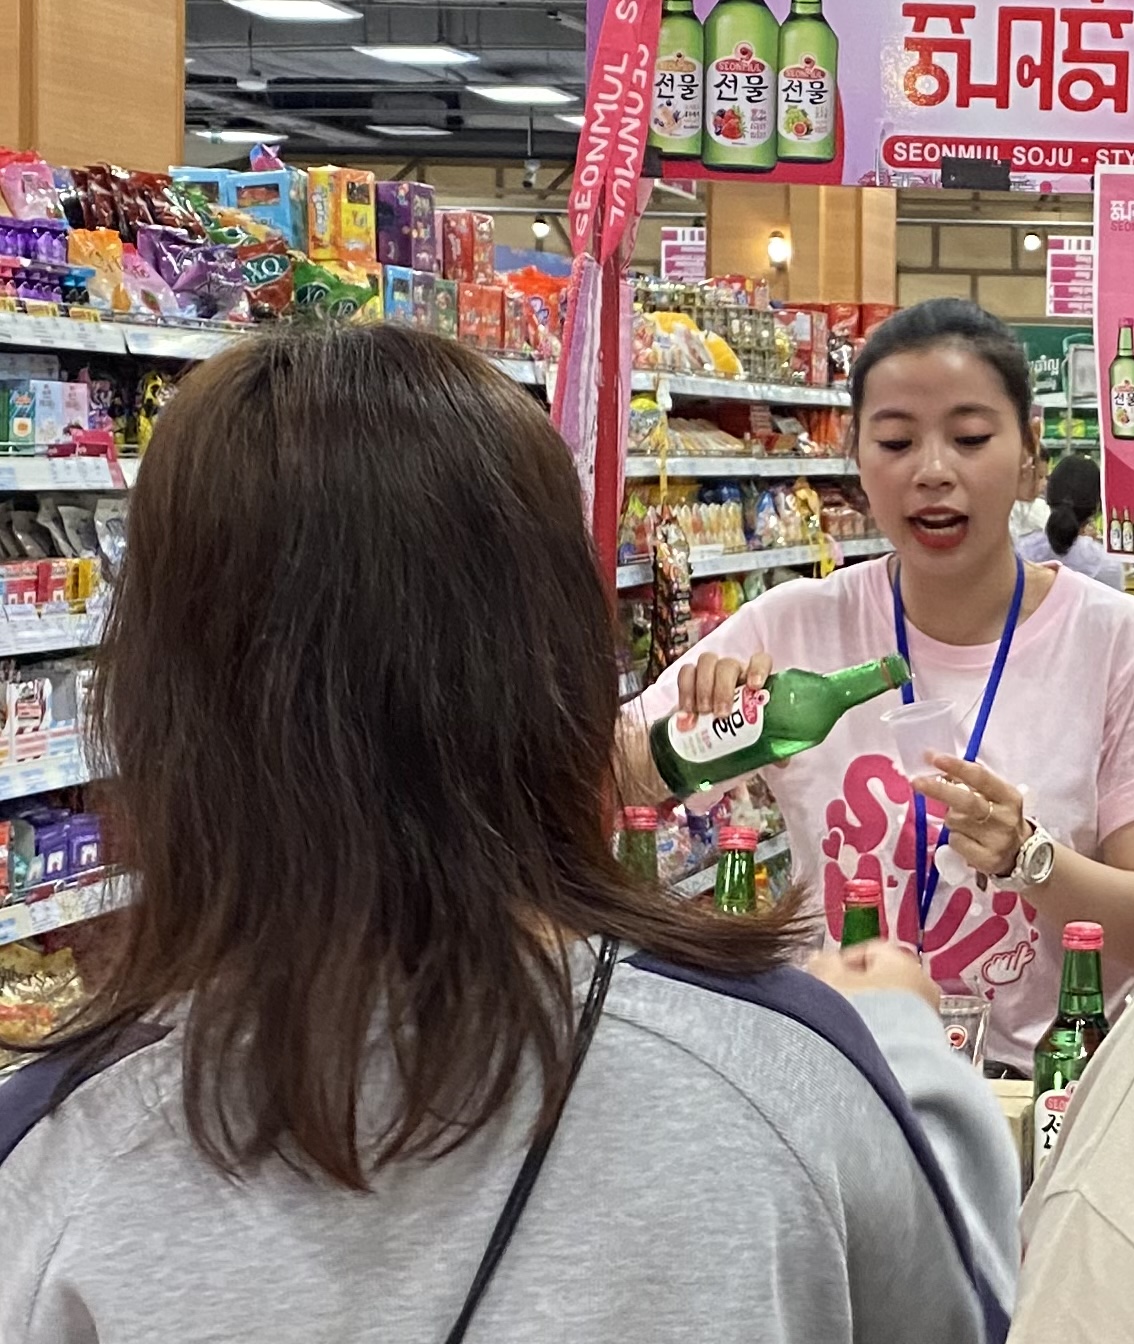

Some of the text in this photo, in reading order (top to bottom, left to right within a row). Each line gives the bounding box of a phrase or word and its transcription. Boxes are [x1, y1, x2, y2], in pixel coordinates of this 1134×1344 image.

[654, 73, 699, 100] 선물
[714, 74, 768, 103] 선물
[782, 80, 828, 104] 선물
[575, 53, 628, 236] SEONMUL
[1012, 146, 1073, 168] SOJU
